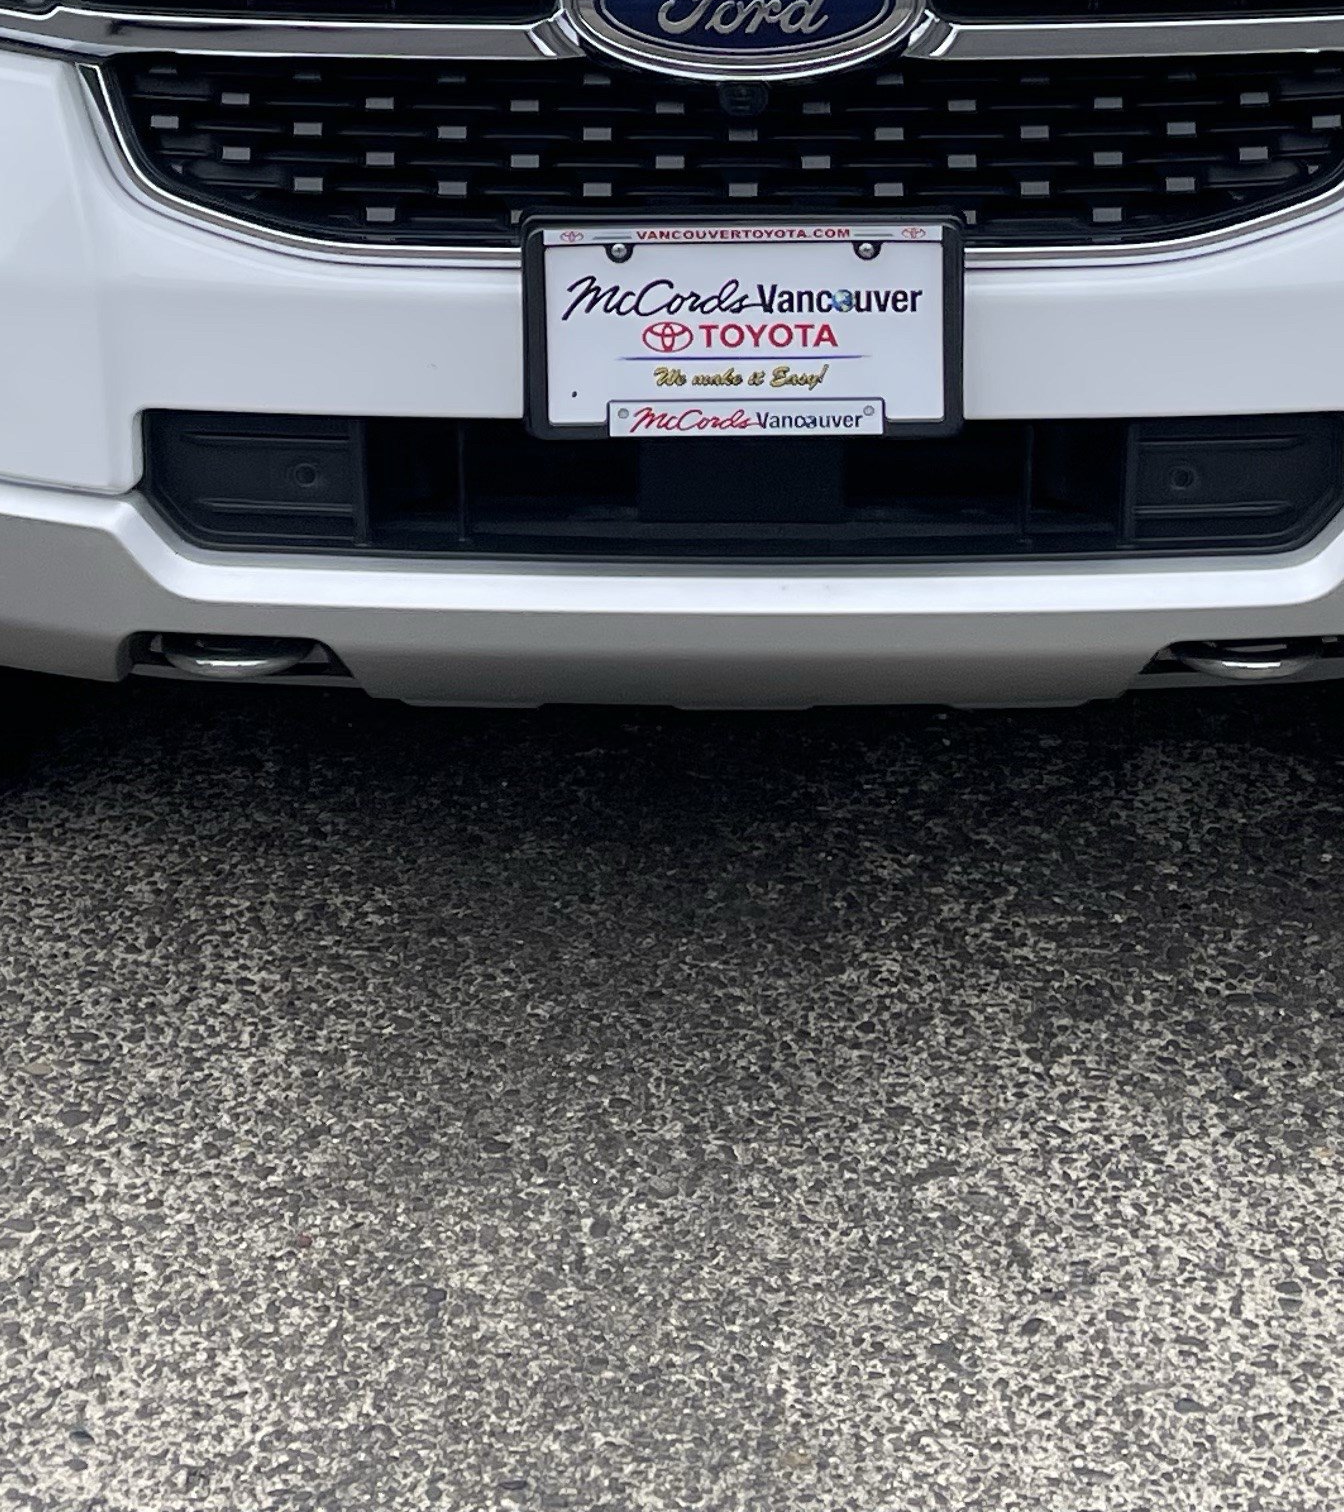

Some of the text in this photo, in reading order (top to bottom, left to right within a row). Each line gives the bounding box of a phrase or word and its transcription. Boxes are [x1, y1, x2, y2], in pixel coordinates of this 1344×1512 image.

[636, 228, 851, 241] VANCOUVERTOYOTA.COM
[698, 323, 839, 349] TOYOTA
[654, 366, 687, 388] We
[691, 367, 744, 387] make
[770, 363, 830, 391] Easy!
